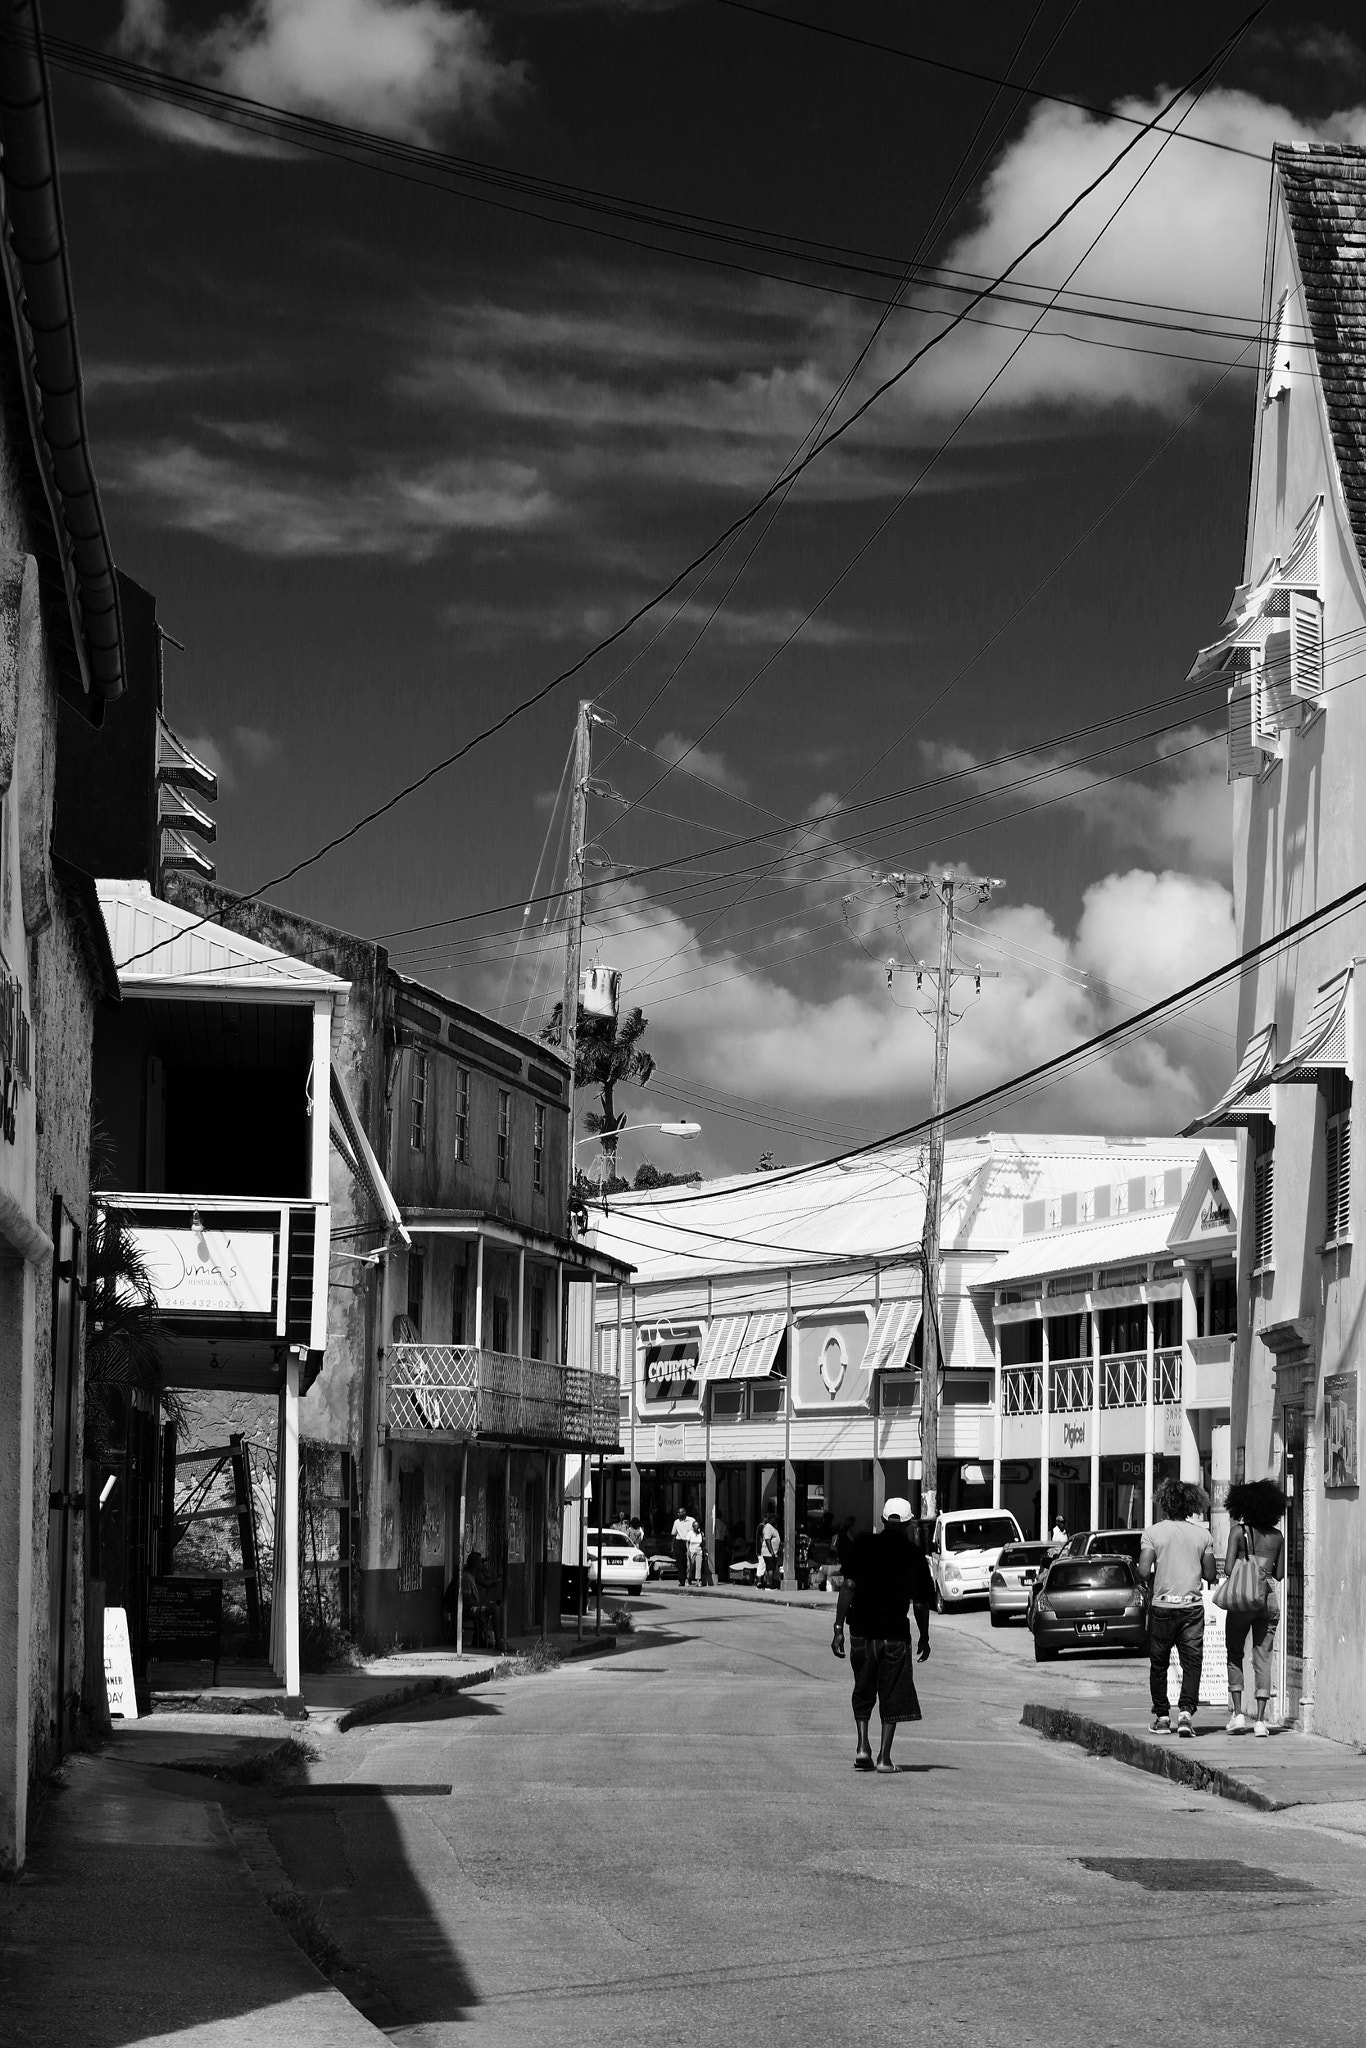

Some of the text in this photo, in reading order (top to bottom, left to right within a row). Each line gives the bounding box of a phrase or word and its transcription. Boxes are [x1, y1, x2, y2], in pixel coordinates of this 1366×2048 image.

[149, 1234, 238, 1290] Juma's
[188, 1279, 233, 1287] RESTAURANT
[165, 1298, 245, 1309] 246-432-0232
[648, 1358, 696, 1383] COURTS
[1063, 1421, 1085, 1449] Digicel
[677, 1469, 706, 1478] COURT
[1122, 1461, 1160, 1476] Digiel
[1081, 1623, 1100, 1632] A914
